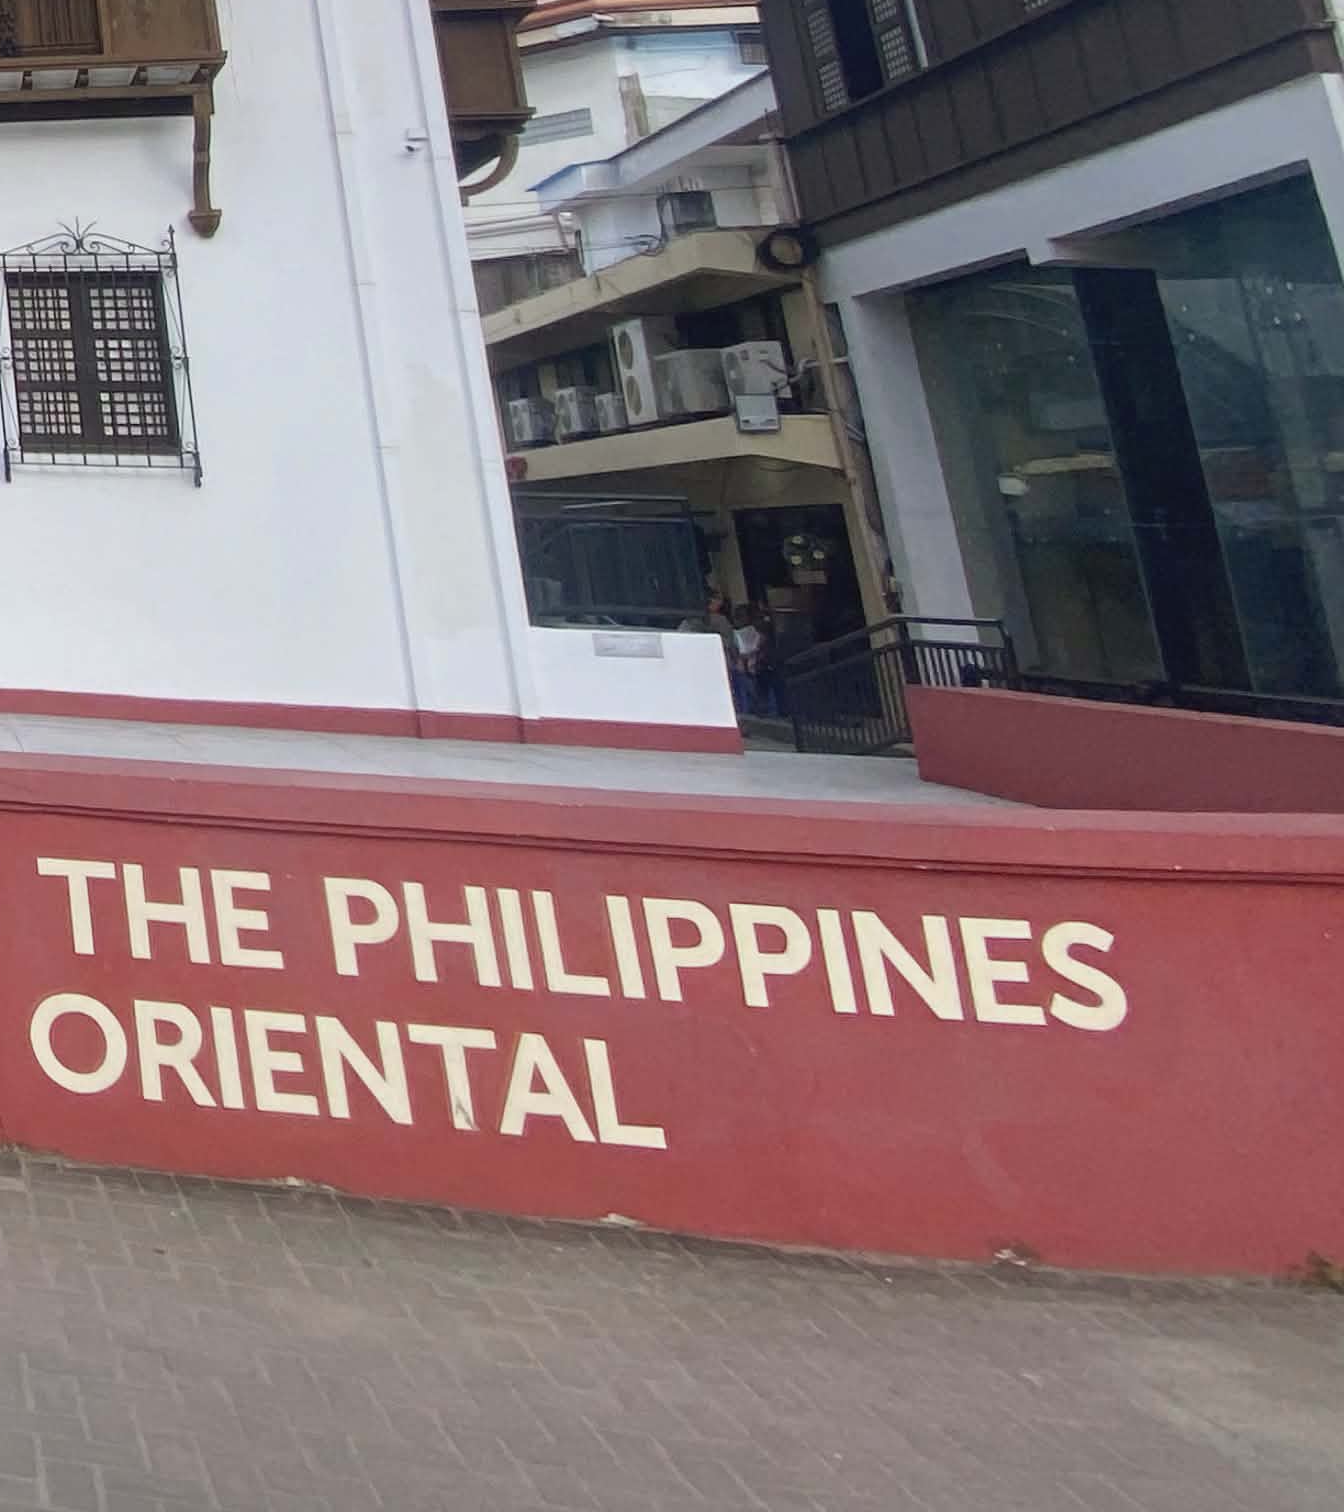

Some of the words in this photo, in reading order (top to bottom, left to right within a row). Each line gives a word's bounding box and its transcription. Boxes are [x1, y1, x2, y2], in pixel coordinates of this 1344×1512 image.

[35, 856, 286, 971] THE
[321, 875, 1129, 1033] PHILIPPINES
[28, 991, 669, 1151] ORIENTAL
